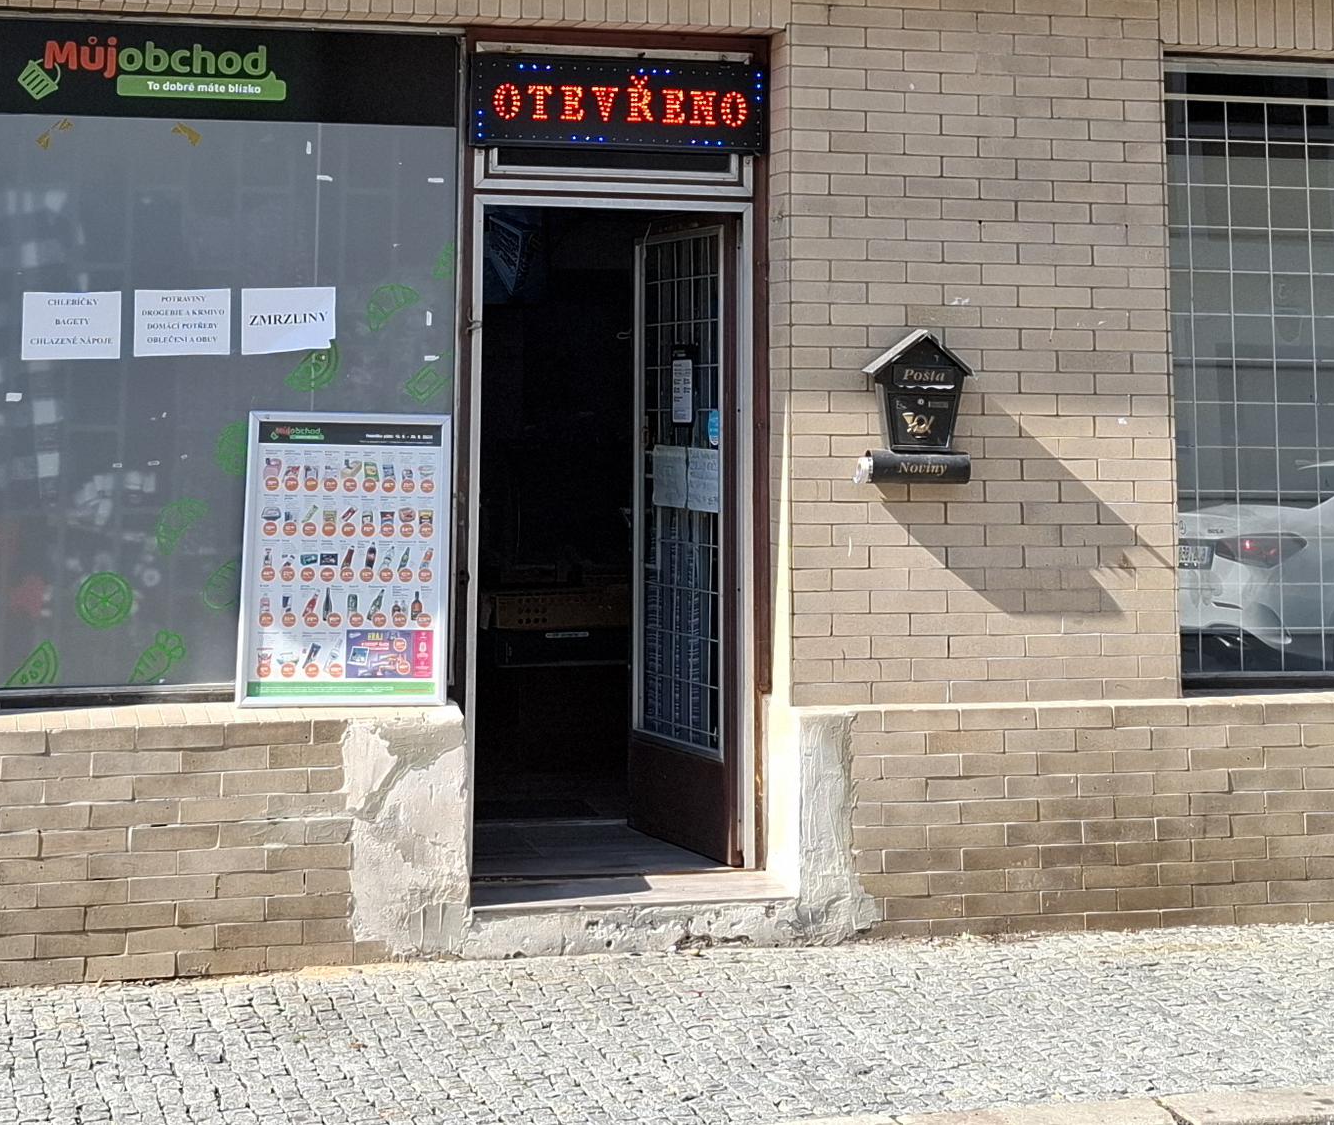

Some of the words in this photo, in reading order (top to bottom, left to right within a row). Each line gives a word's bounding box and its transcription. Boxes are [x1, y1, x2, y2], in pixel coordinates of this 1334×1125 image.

[147, 81, 160, 90] To
[162, 81, 195, 92] dobré
[198, 82, 226, 92] máte
[228, 83, 261, 94] blízko
[493, 75, 748, 127] OTEVŘENO
[47, 297, 99, 306] CHLEBÍČKY
[147, 322, 180, 330] DOMÁCÍ
[182, 321, 218, 329] POTŘEBY
[249, 311, 328, 327] ZMRZLINY
[30, 336, 77, 345] CHLAZENÉ
[80, 336, 113, 345] NÁPOJE
[899, 461, 948, 476] Noviny
